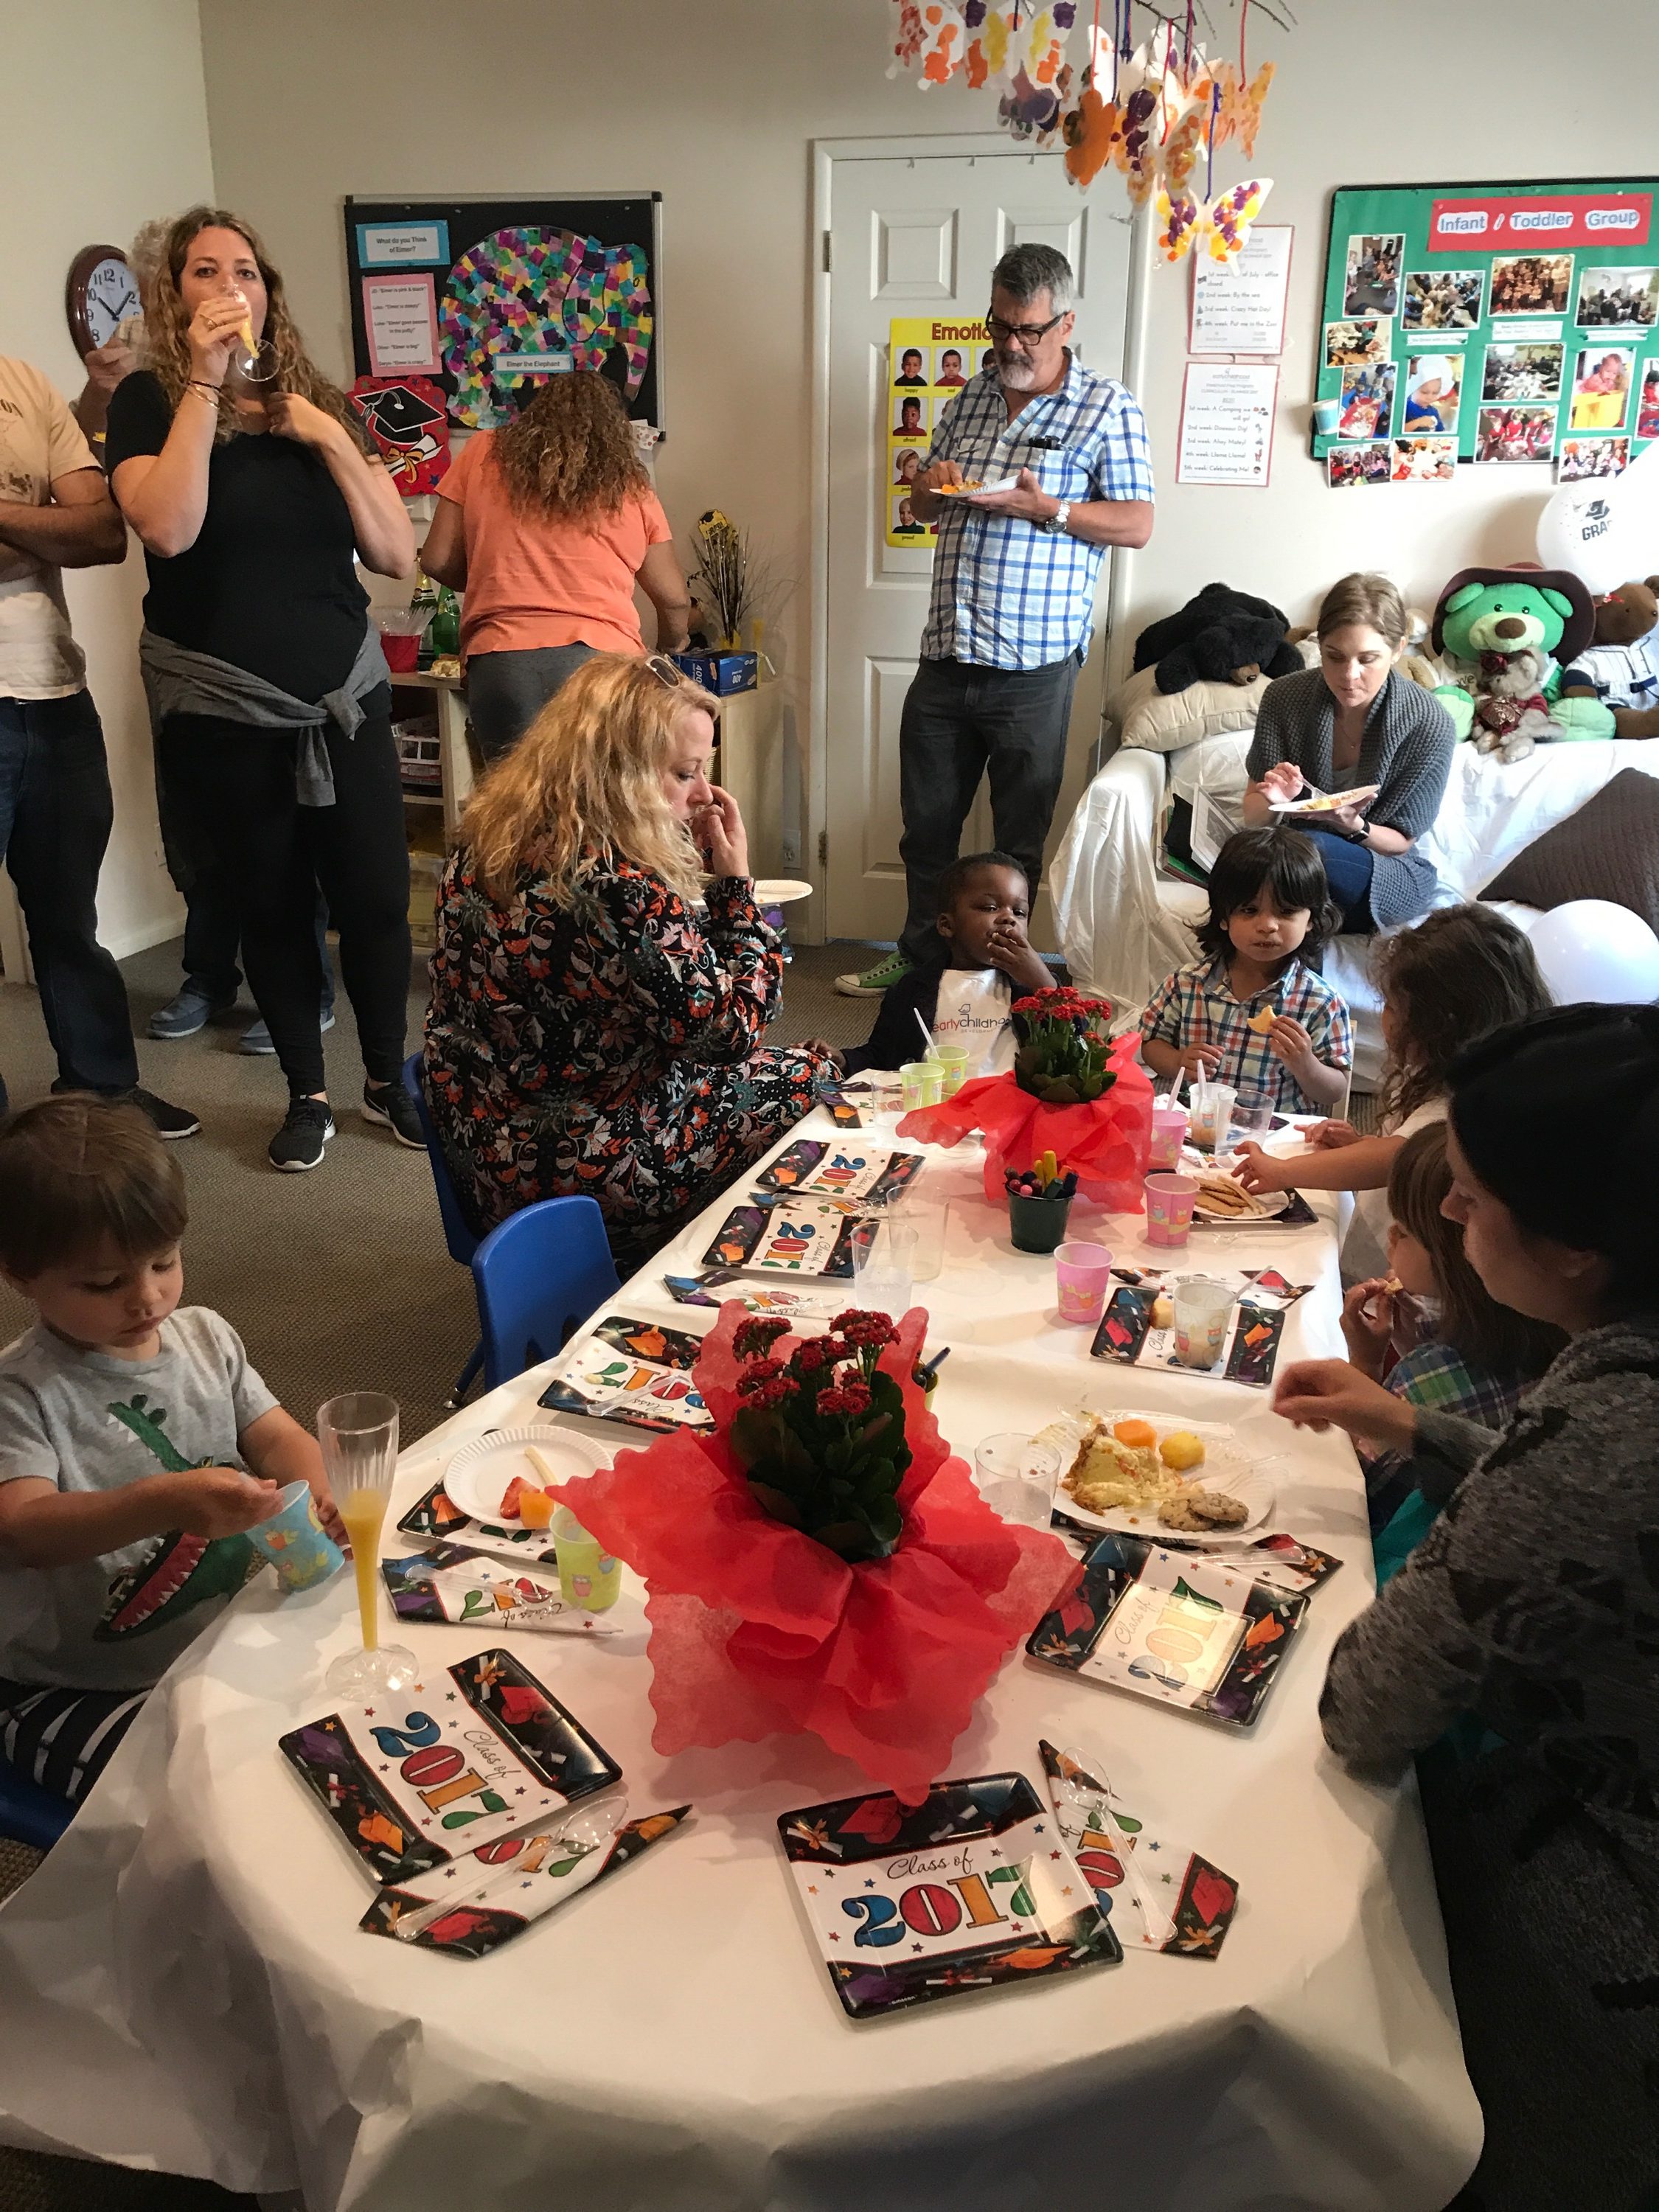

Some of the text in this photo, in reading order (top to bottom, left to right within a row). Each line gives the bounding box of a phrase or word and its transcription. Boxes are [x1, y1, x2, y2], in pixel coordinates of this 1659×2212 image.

[1439, 215, 1485, 232] Infant
[1512, 212, 1573, 227] Toddler
[1587, 210, 1639, 226] Group
[94, 274, 102, 285] 11
[104, 268, 116, 282] 12
[87, 288, 97, 301] 10
[86, 308, 94, 321] 9
[91, 329, 100, 342] 8
[932, 322, 992, 340] Emotio
[1116, 1604, 1145, 1645] Class
[463, 1730, 521, 1779] Class of
[369, 1711, 515, 1830] 2017
[886, 1846, 974, 1879] Class of
[841, 1855, 1038, 1949] 2017
